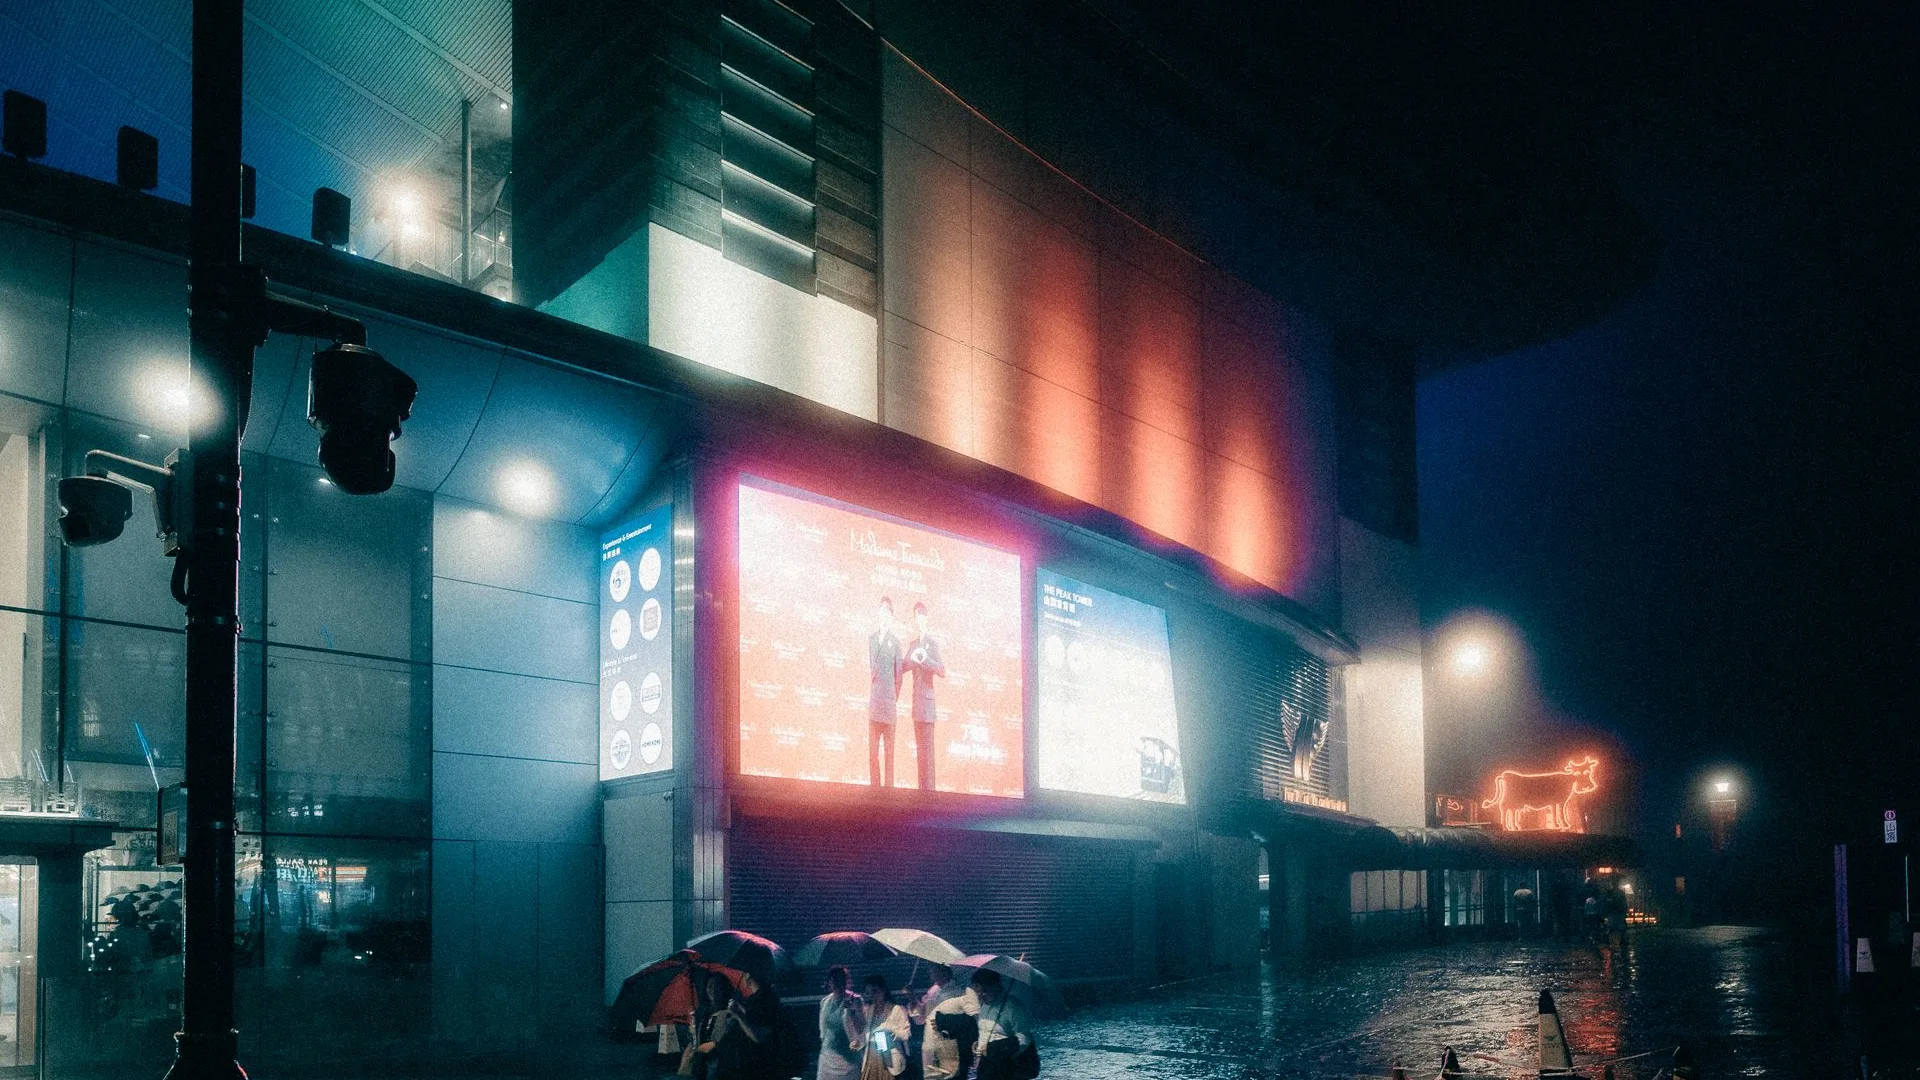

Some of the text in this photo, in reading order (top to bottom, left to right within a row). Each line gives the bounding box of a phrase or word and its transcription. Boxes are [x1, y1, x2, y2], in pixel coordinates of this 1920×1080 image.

[1043, 584, 1093, 607] THE PEAK TOWER
